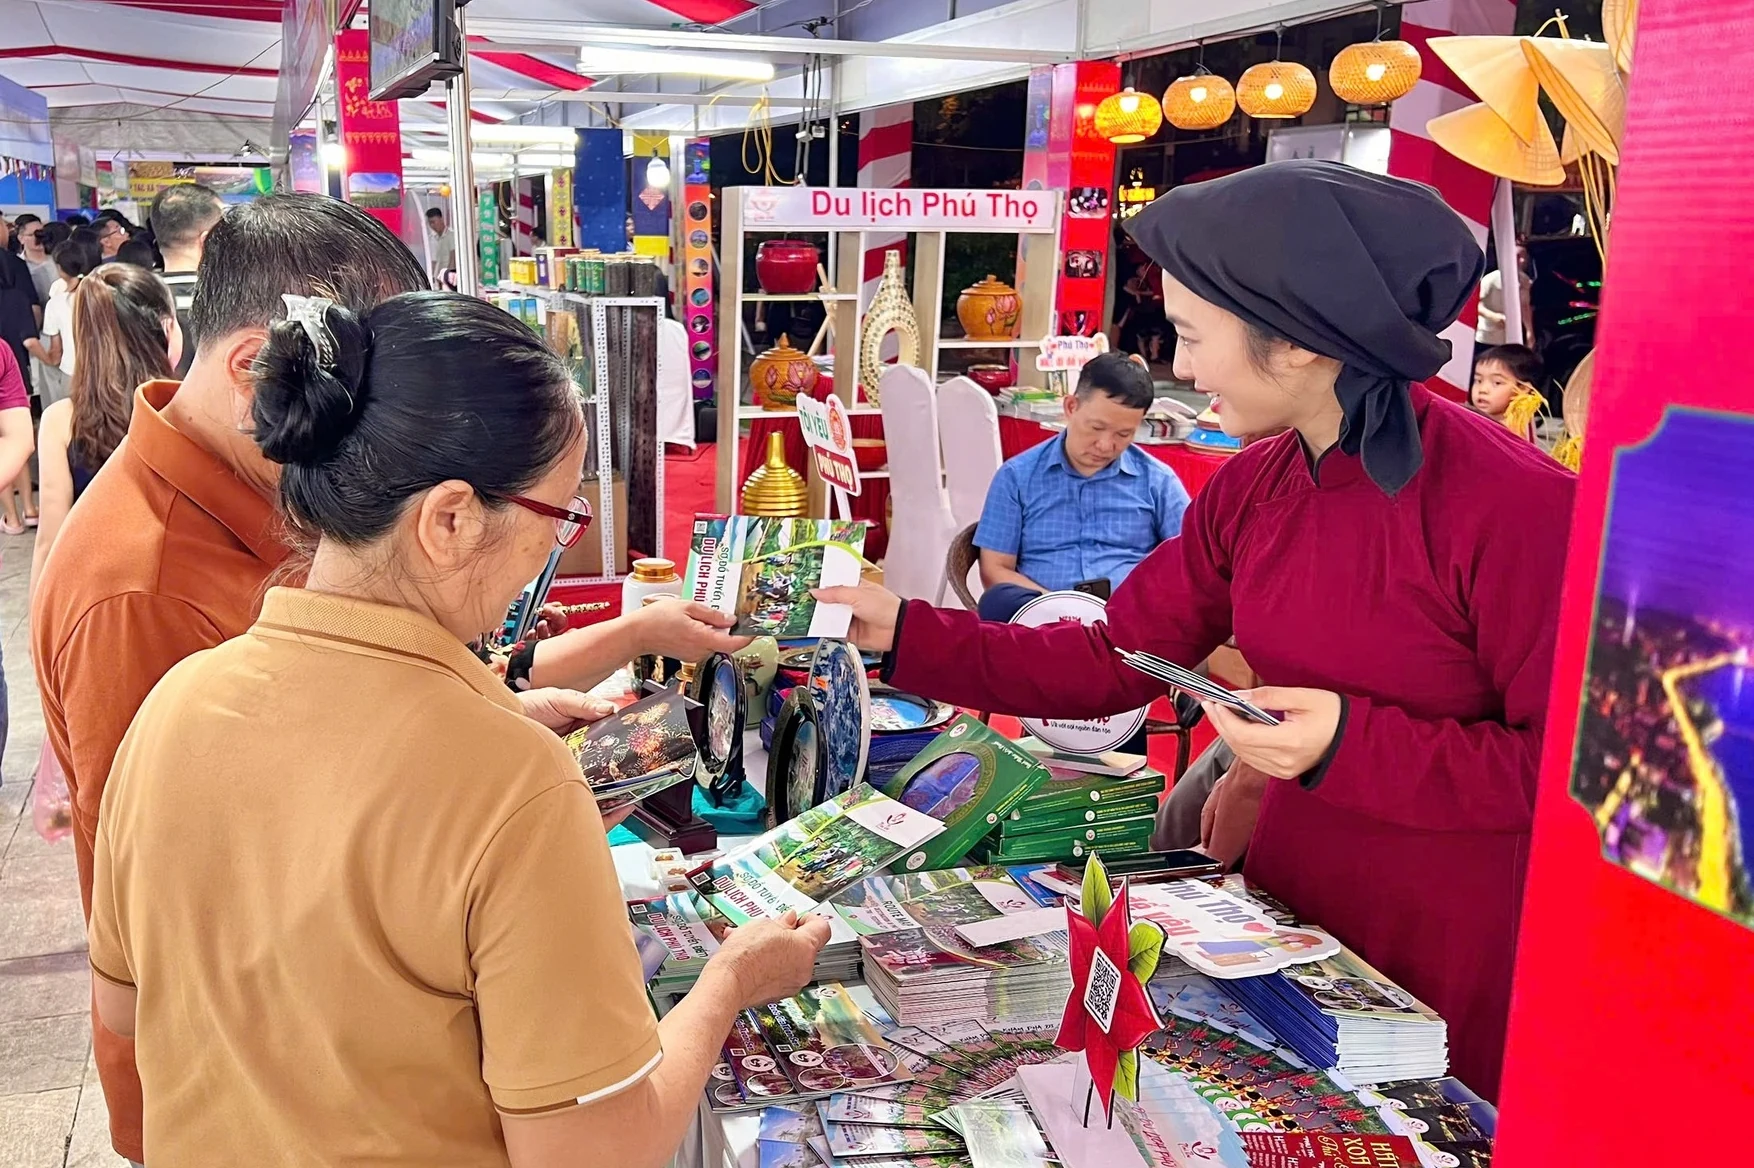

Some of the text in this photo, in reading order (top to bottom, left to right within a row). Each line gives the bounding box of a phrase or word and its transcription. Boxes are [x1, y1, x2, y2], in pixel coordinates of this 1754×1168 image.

[812, 190, 1038, 224] Du lịch Phú Thọ
[799, 406, 829, 440] TÔI YÊU
[817, 451, 854, 491] PHÚ THỌ
[694, 581, 708, 602] PHÚ
[714, 876, 765, 918] DU LỊCH PHÚ
[881, 899, 903, 917] ROUTE
[1161, 880, 1256, 923] Phú Thọ
[1132, 912, 1200, 936] yêu
[1370, 1142, 1400, 1168] HÁT
